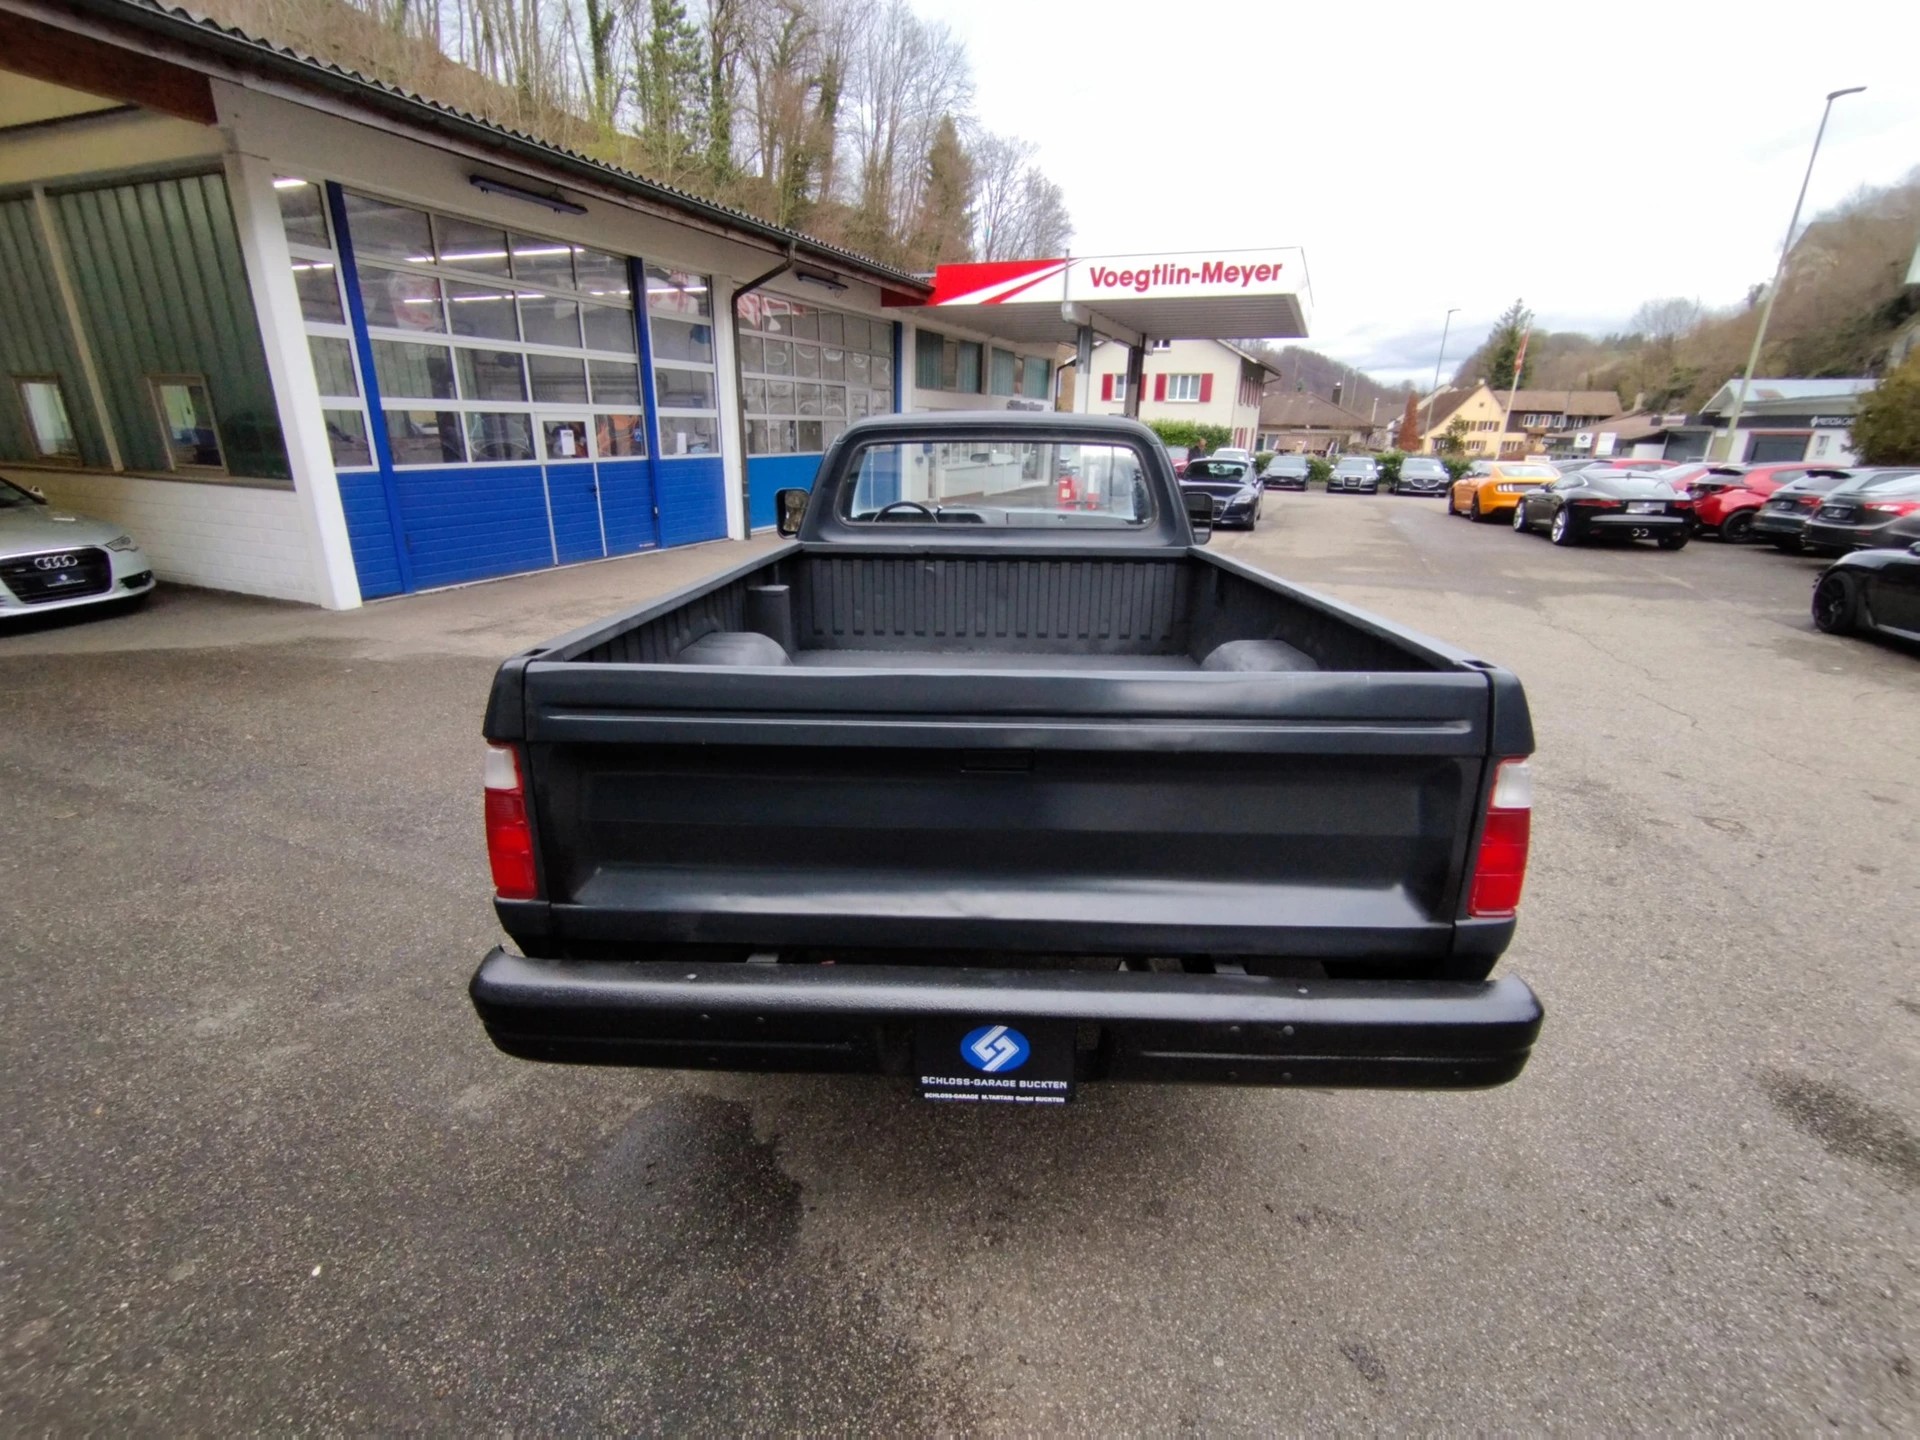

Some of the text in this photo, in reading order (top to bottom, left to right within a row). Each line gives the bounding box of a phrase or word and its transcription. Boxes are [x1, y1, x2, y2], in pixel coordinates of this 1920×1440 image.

[1089, 261, 1283, 292] Voegtlin-Meyer
[921, 1076, 1067, 1089] SCHLOSS-GARAGE BUCKTEN
[924, 1092, 979, 1100] SCHLOSS-GARAGE
